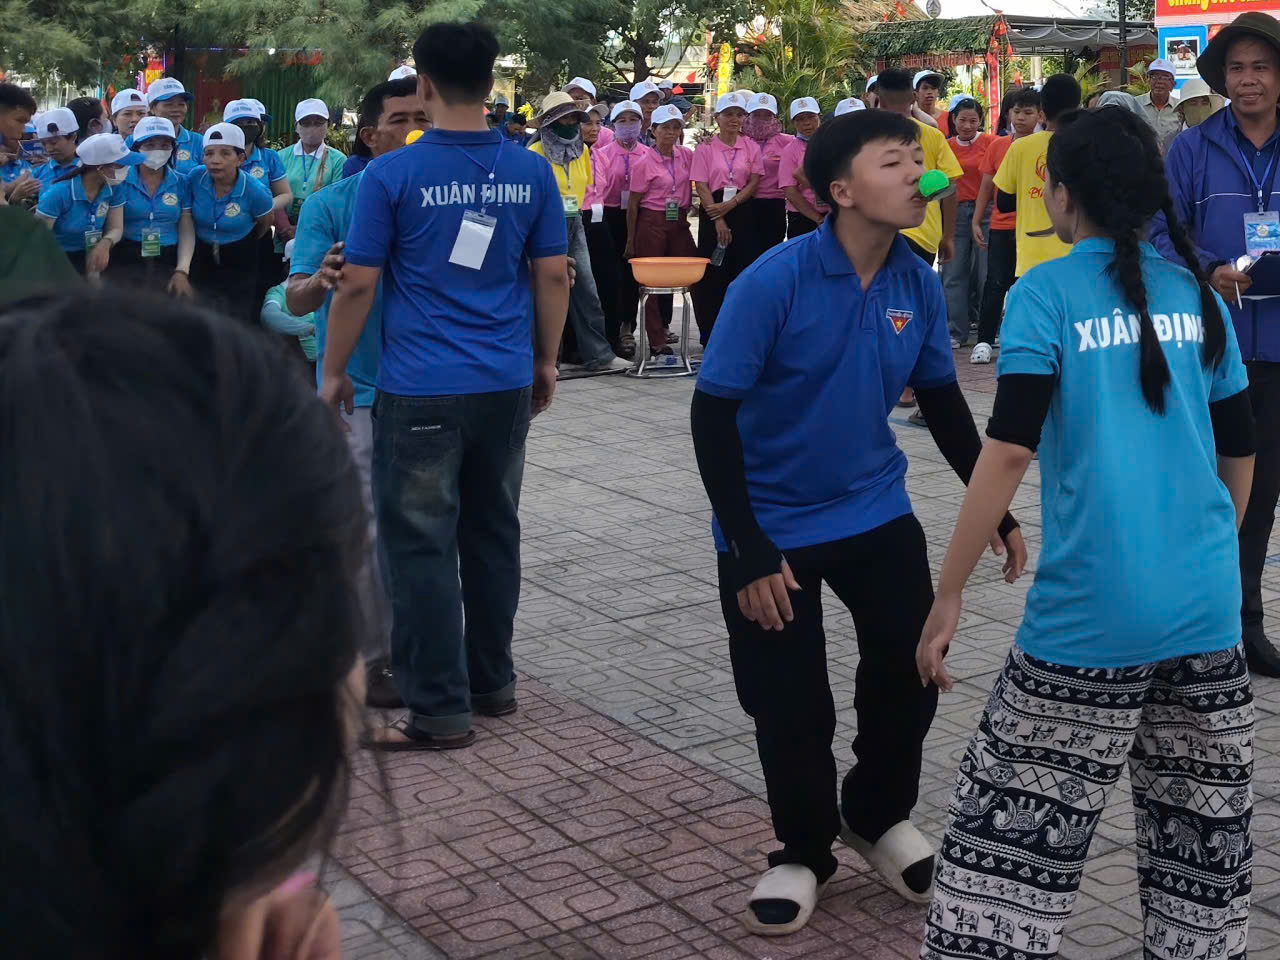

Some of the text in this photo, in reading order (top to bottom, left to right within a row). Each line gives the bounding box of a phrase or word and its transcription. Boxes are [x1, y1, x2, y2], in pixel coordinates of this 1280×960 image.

[420, 181, 531, 208] XUÂN ĐỊNH
[1074, 307, 1204, 352] XUÂN ĐỊN
